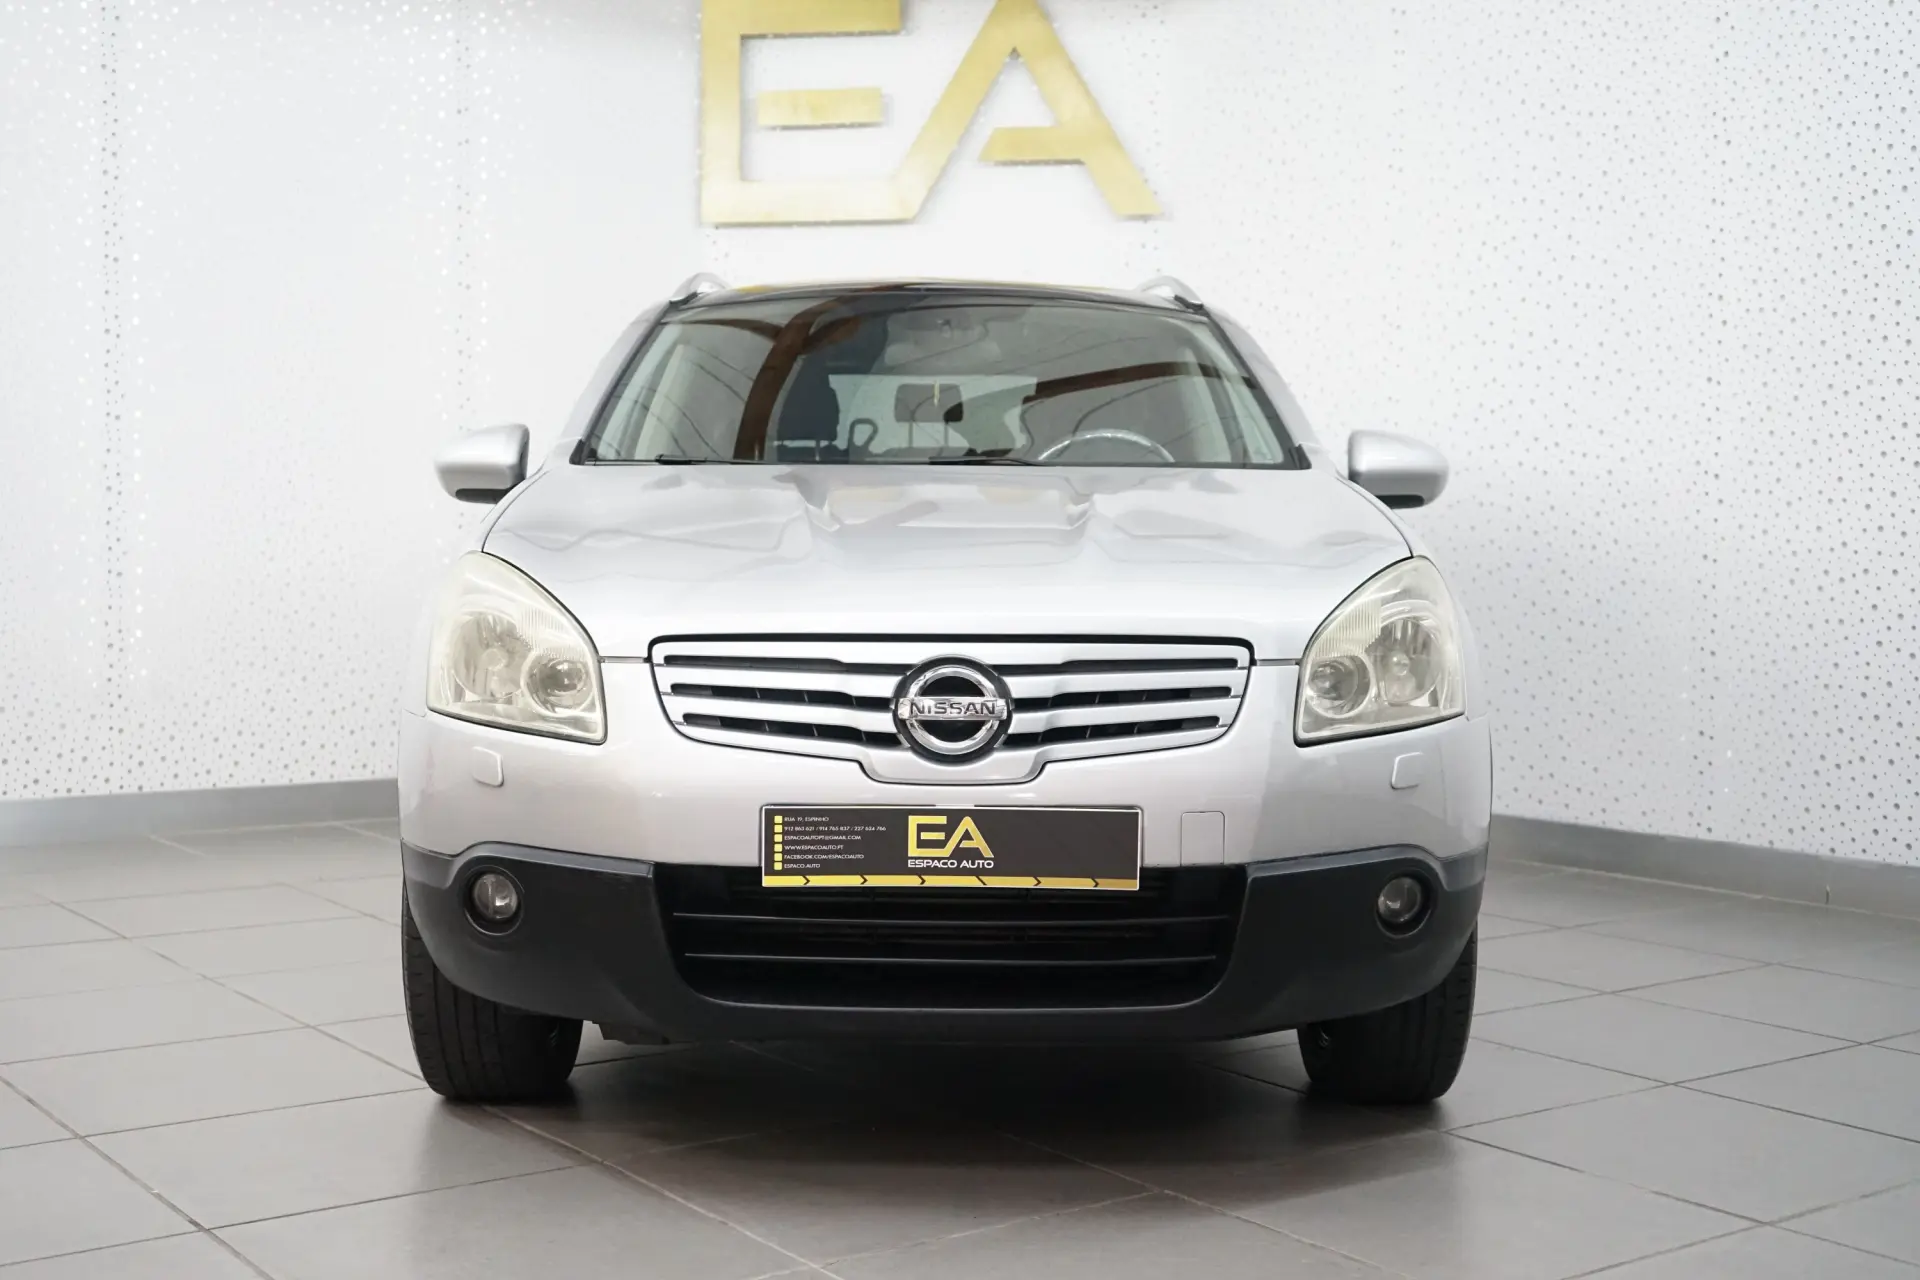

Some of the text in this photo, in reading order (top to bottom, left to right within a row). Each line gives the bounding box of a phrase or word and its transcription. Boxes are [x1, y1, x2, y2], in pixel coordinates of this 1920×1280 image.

[701, 0, 1162, 223] EA
[910, 701, 996, 715] NISSAN
[908, 815, 995, 858] EA
[908, 859, 995, 869] ESPACO AUTO
